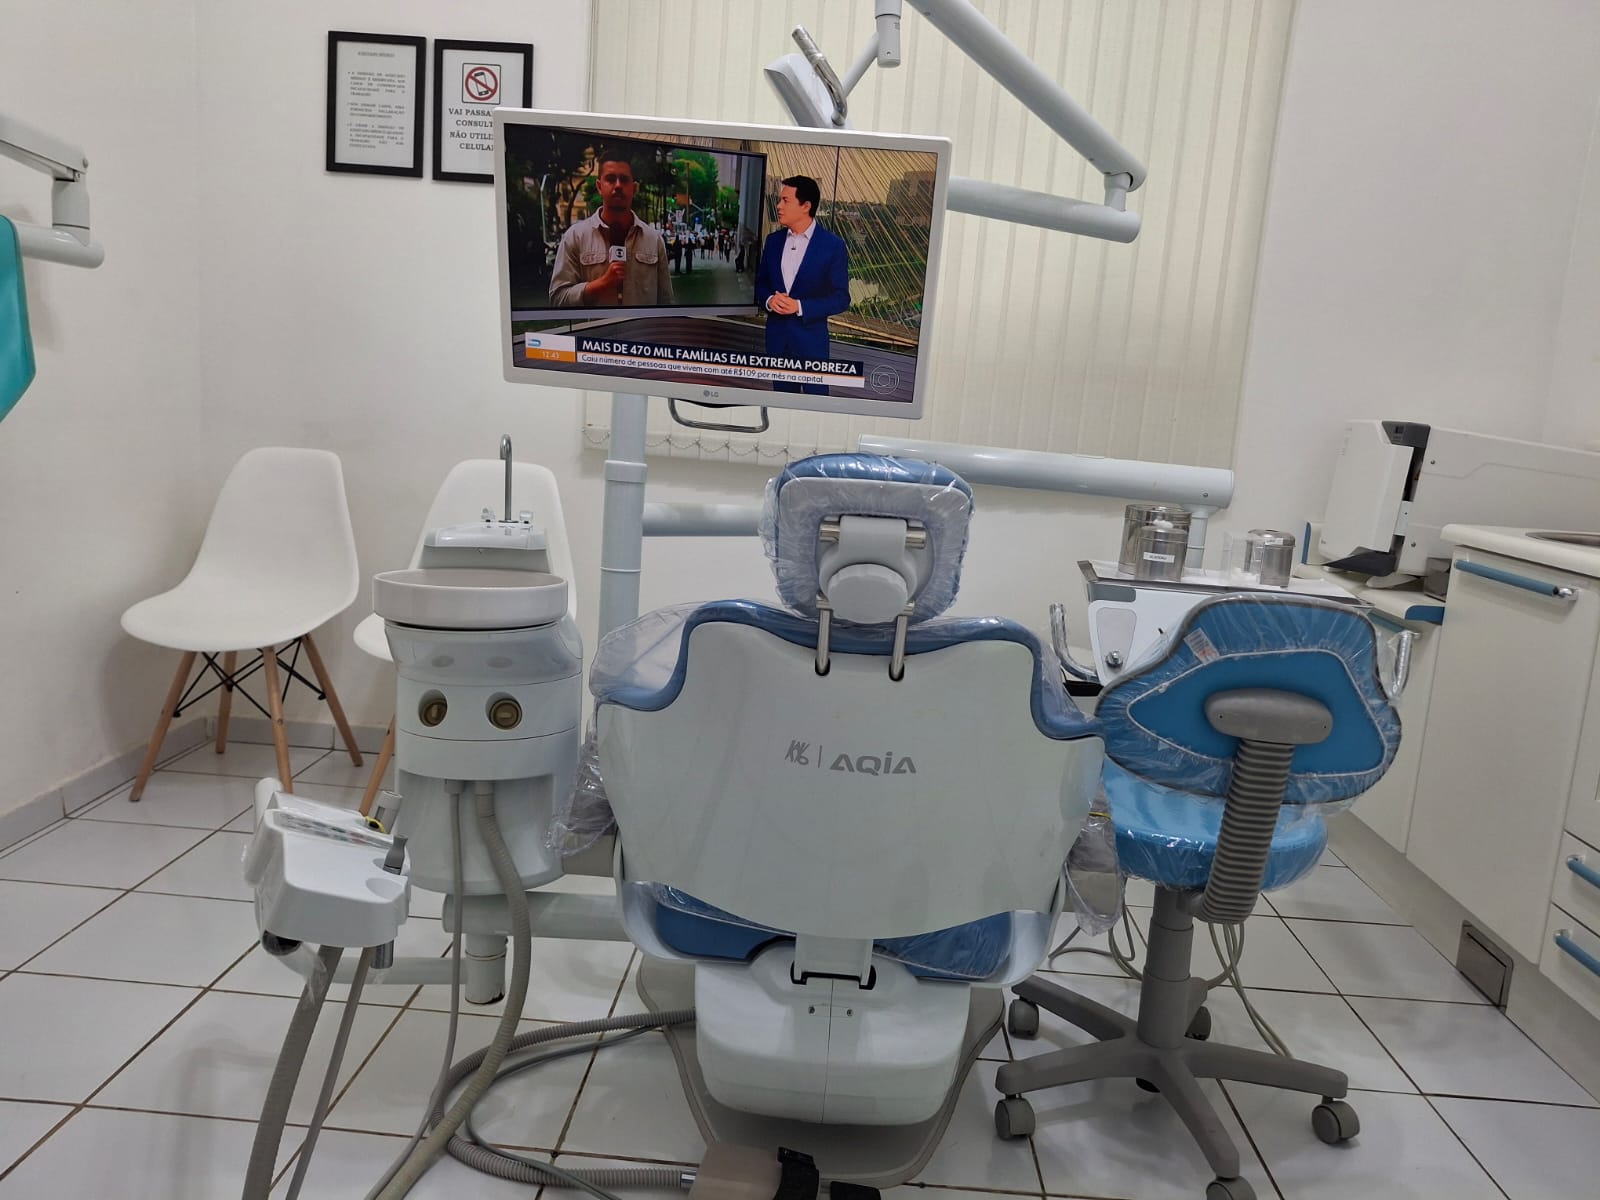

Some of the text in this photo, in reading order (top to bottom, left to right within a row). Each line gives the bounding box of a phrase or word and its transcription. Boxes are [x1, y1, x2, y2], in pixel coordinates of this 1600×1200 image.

[448, 108, 463, 116] VAI
[449, 130, 467, 139] NÃO
[582, 340, 857, 375] MAIS DE 470 MIL FAMÍLIAS EM EXTREMA POBREZA
[581, 353, 599, 363] Caiu
[599, 355, 627, 366] número
[626, 358, 637, 367] de
[637, 360, 667, 369] pessoas
[667, 363, 681, 372] que
[682, 364, 703, 373] vivem
[720, 367, 733, 375] até
[733, 369, 756, 378] R$109
[757, 371, 770, 379] por
[771, 373, 786, 381] mês
[797, 375, 824, 384] capital
